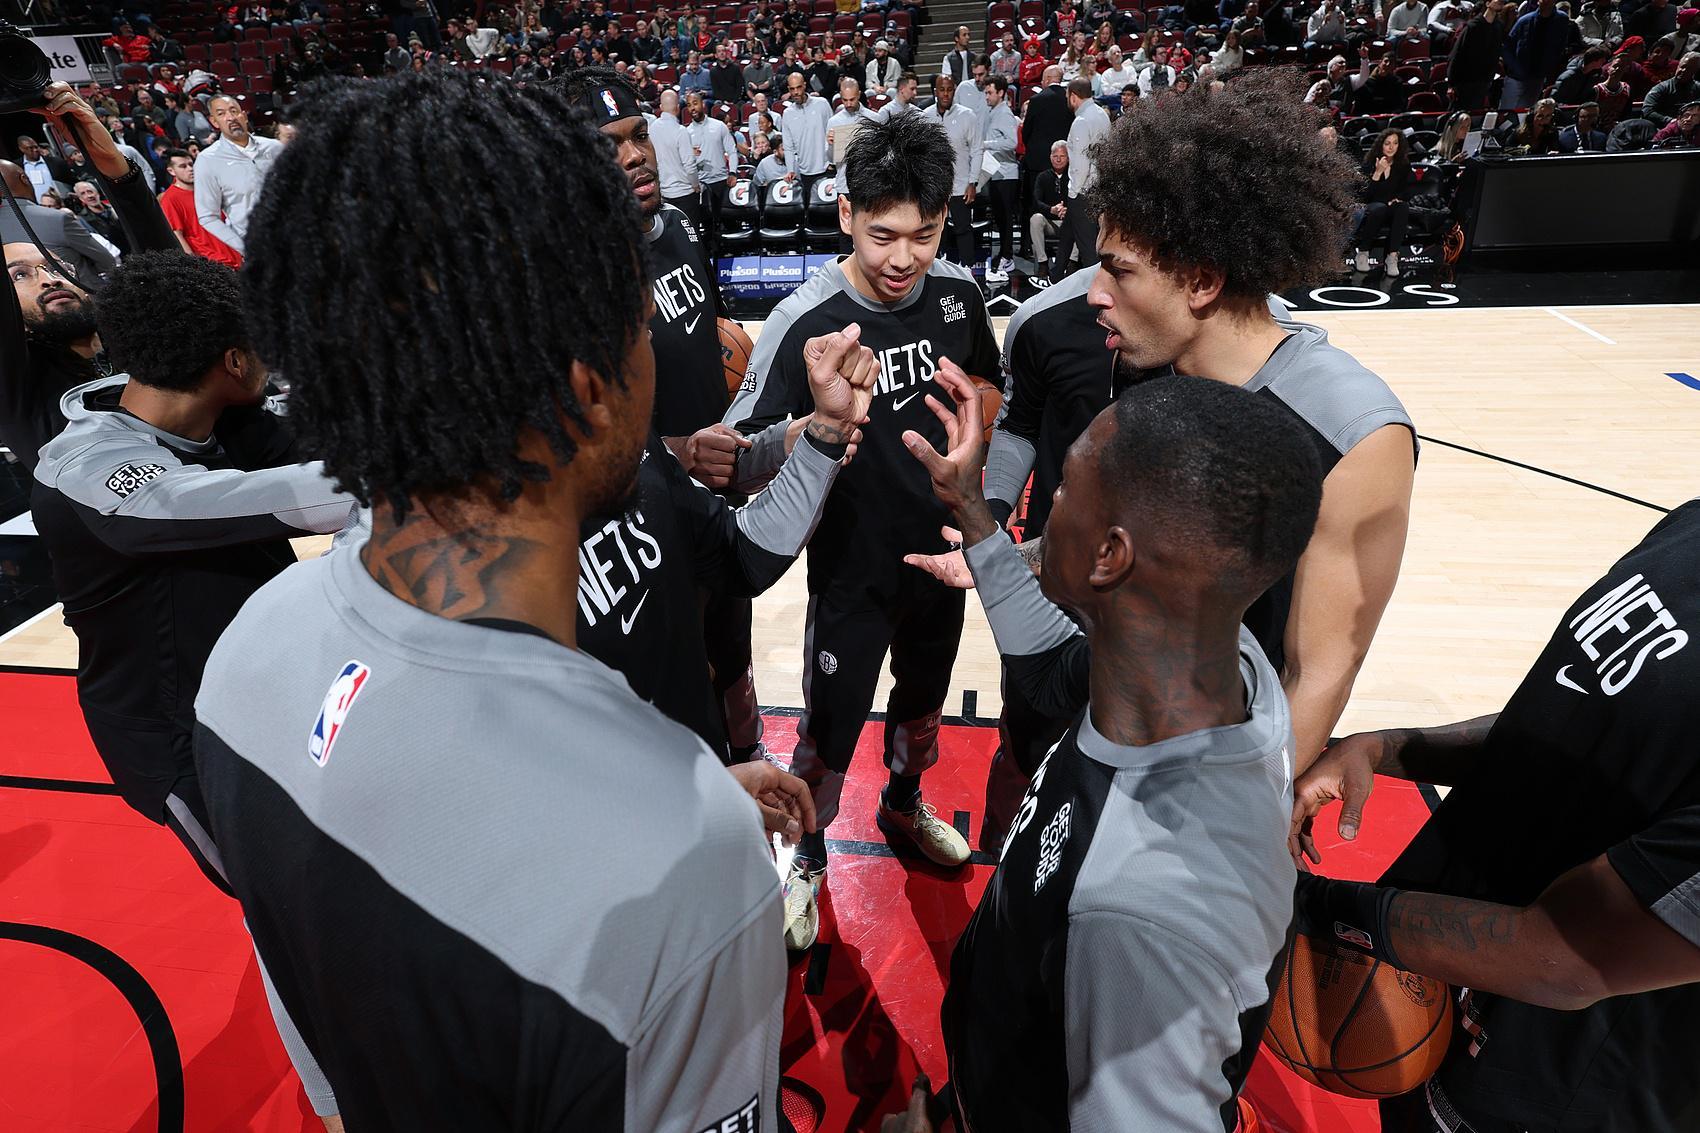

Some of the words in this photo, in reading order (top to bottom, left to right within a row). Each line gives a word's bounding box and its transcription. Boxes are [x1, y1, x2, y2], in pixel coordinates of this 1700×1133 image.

[49, 52, 77, 69] te
[720, 266, 759, 277] Plus500
[762, 265, 801, 276] Plus500
[653, 263, 706, 324] NETS
[940, 295, 955, 306] GET
[942, 302, 964, 315] YOUR
[944, 310, 967, 323] GUIDE
[108, 464, 132, 491] GET
[577, 509, 662, 627] NETS
[1569, 573, 1689, 696] NETS
[1058, 802, 1071, 843] GET
[1046, 811, 1061, 877] YOUR
[1033, 825, 1051, 893] GUIDE
